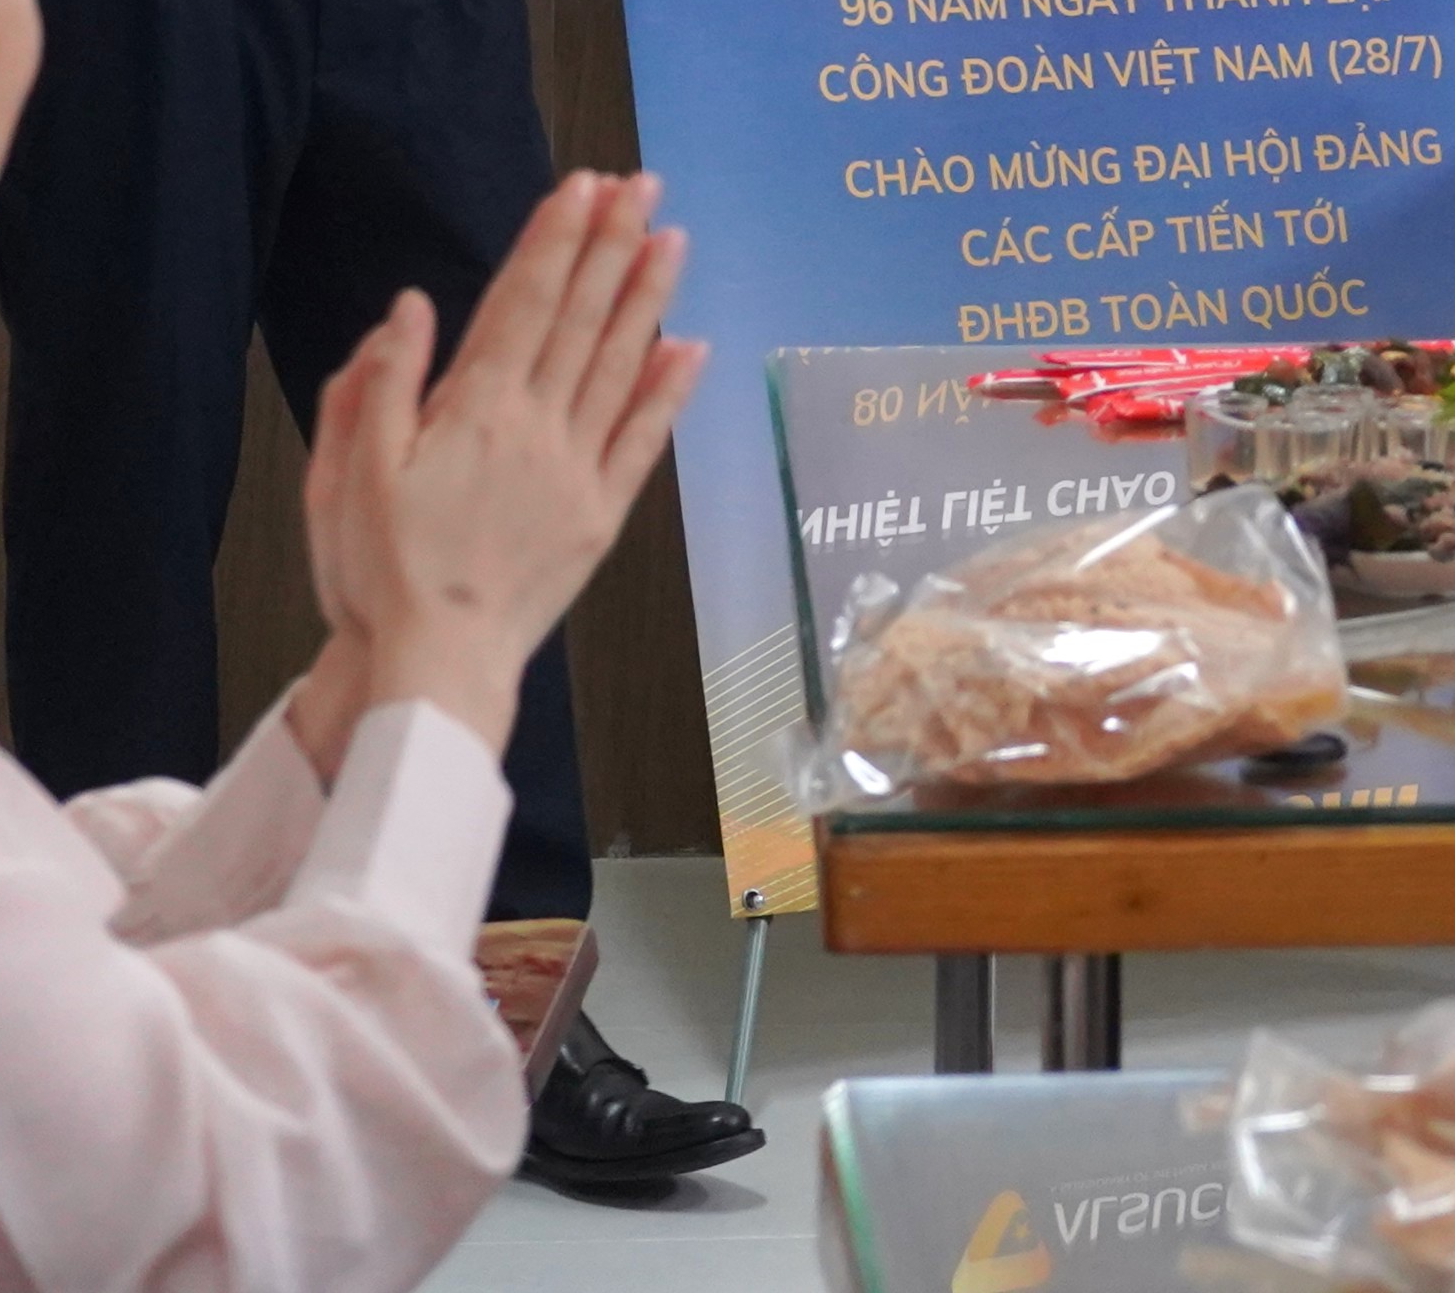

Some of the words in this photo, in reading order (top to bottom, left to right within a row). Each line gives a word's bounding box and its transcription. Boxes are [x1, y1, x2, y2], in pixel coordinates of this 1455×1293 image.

[817, 52, 951, 105] CÔNG
[960, 44, 1097, 98] ĐOÀN
[1103, 38, 1203, 97] VIỆT
[1212, 41, 1316, 85] NAM
[1327, 34, 1445, 87] (28/7)
[843, 146, 978, 201] CHÀO
[987, 140, 1124, 193] MỪNG
[1132, 141, 1214, 190] ĐẠI
[1223, 127, 1304, 185] HỘI
[1312, 121, 1445, 174] ĐẢNG
[960, 217, 1055, 270] CÁC
[1064, 206, 1158, 263] CẤP
[1164, 200, 1267, 256] TIẾN
[1273, 197, 1351, 248] TỚI
[957, 297, 1092, 344] ĐHĐB
[1099, 281, 1230, 332] TOÀN
[1240, 266, 1371, 330] QUỐC
